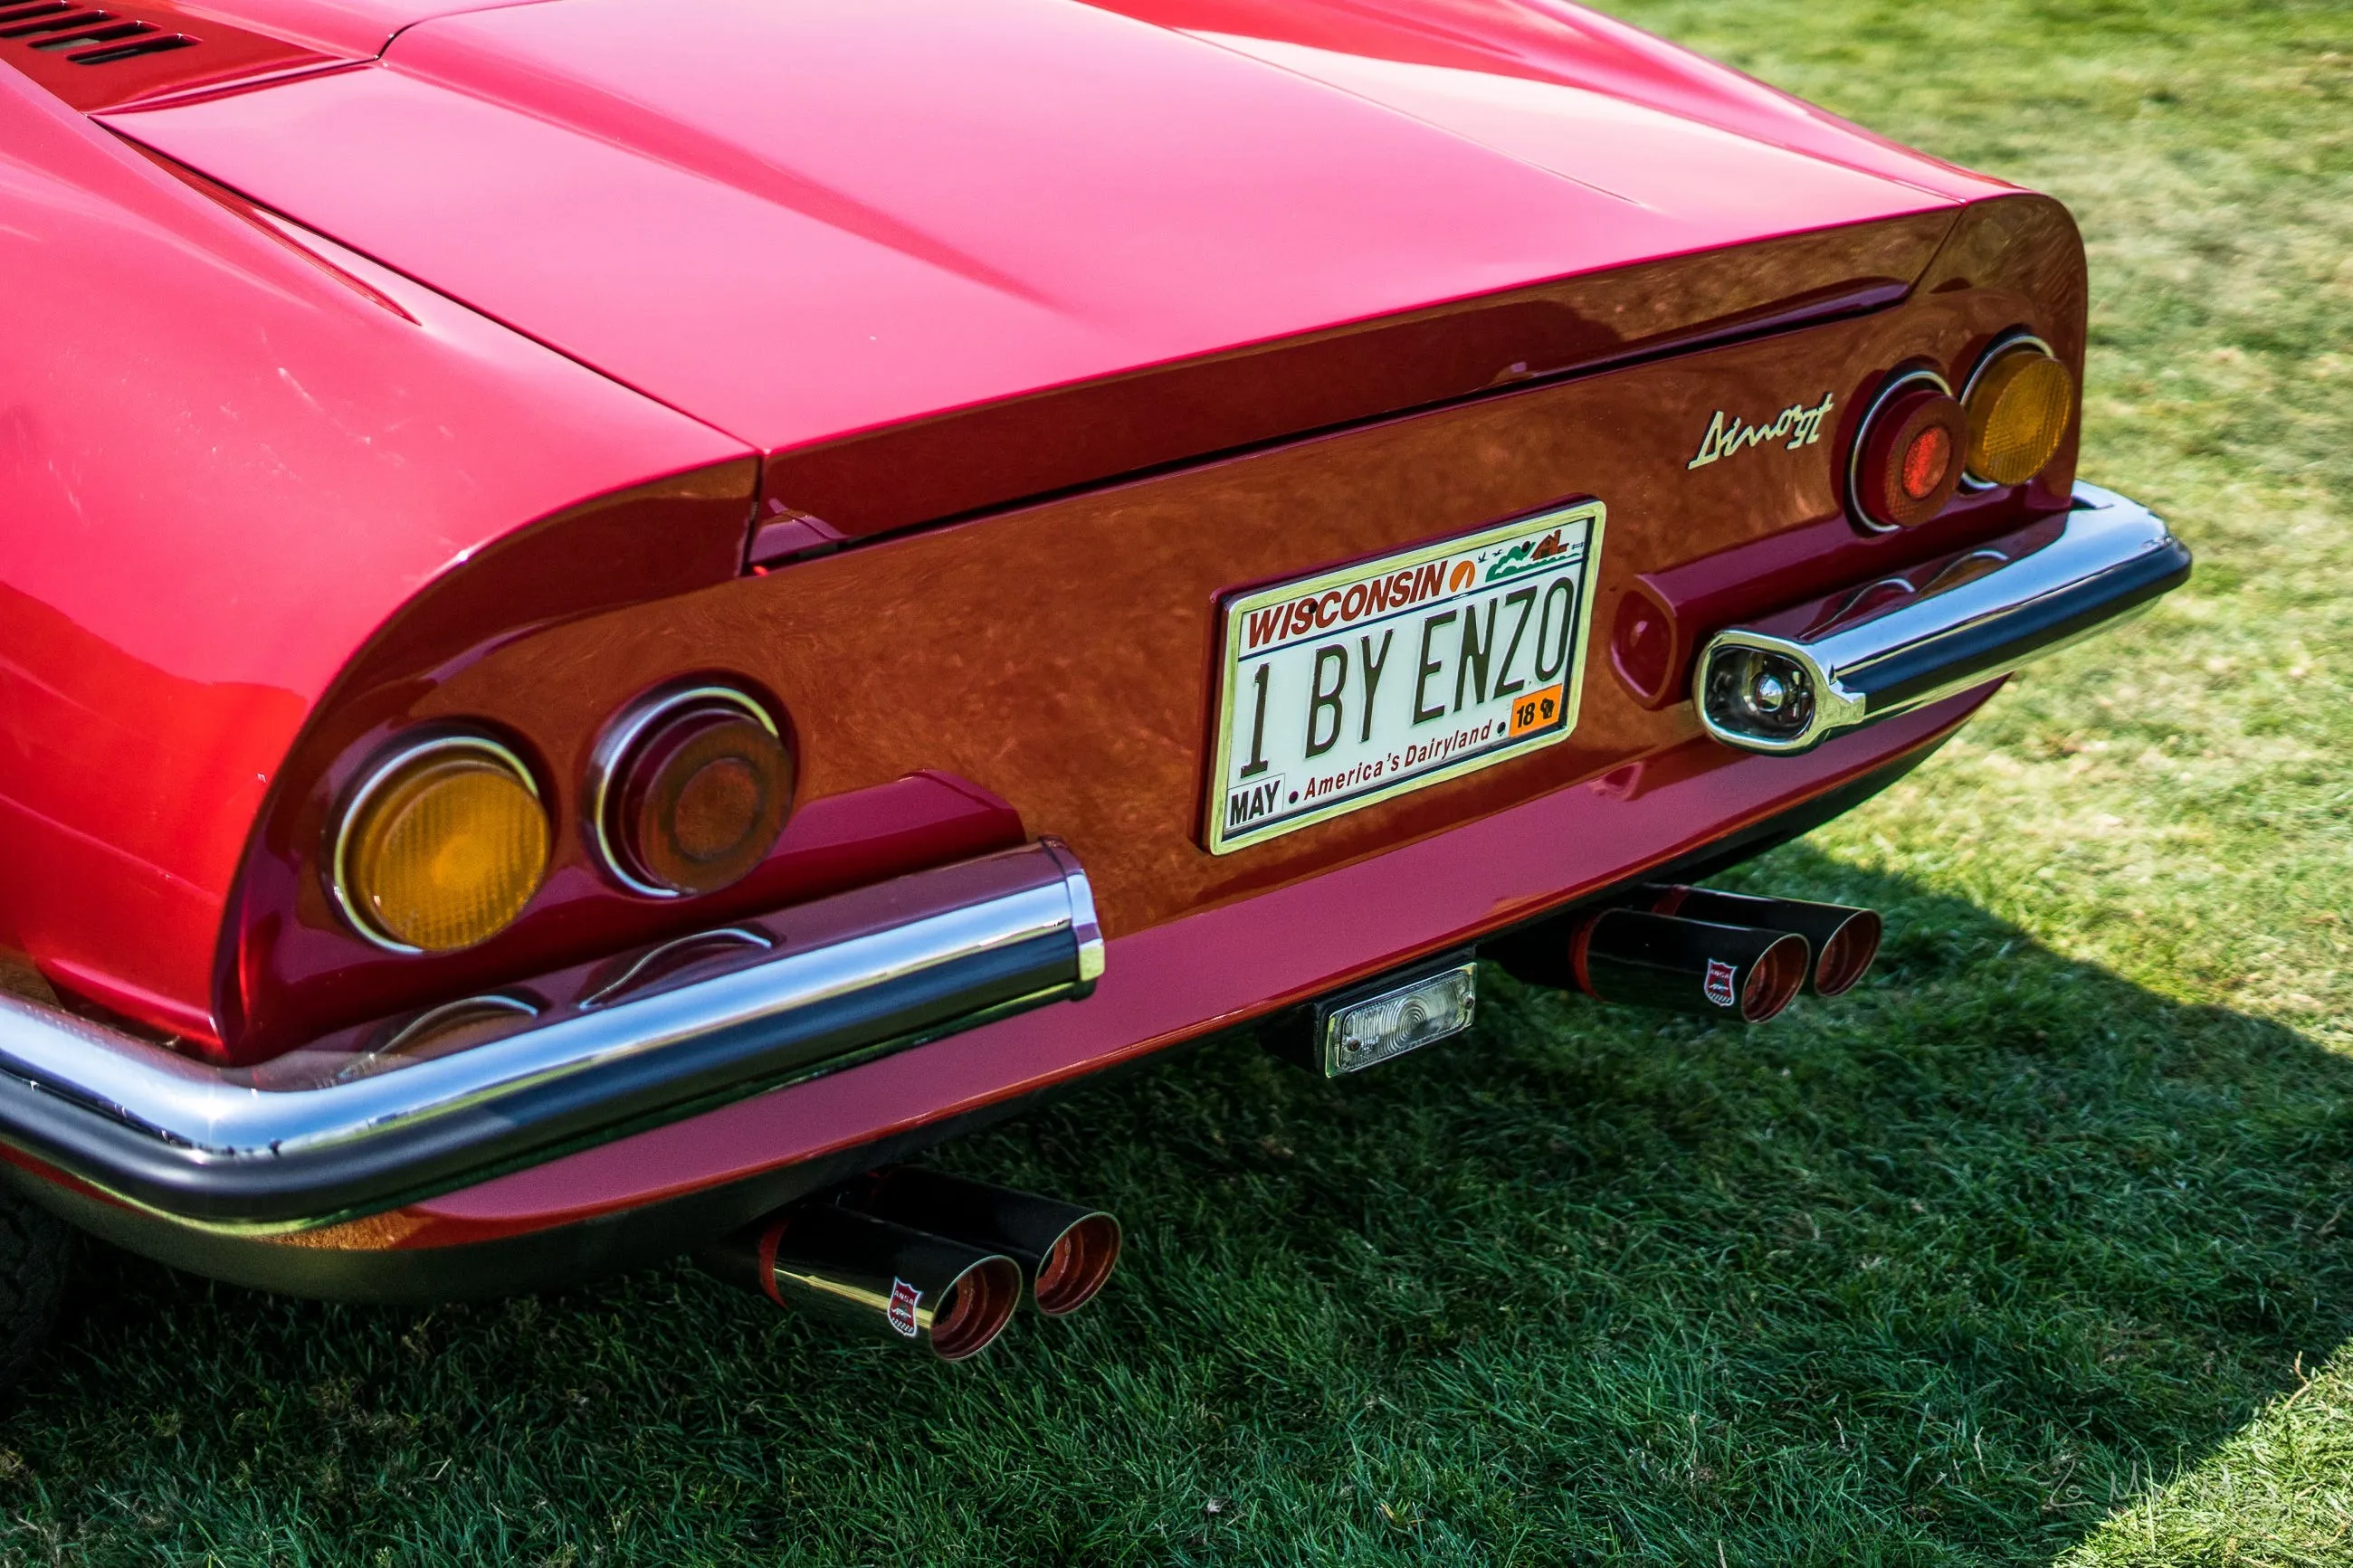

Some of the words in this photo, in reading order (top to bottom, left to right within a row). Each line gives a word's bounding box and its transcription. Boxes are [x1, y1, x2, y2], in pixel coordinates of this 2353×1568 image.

[1248, 560, 1448, 649] WISCONSIN
[1241, 662, 1270, 779] 1
[1305, 628, 1394, 758] BY
[1413, 576, 1575, 725] ENZO
[1516, 701, 1536, 728] 18
[1303, 752, 1400, 801] America's
[1404, 718, 1492, 767] Dairyland
[1229, 779, 1281, 826] MAY
[894, 1290, 914, 1306] ANSA
